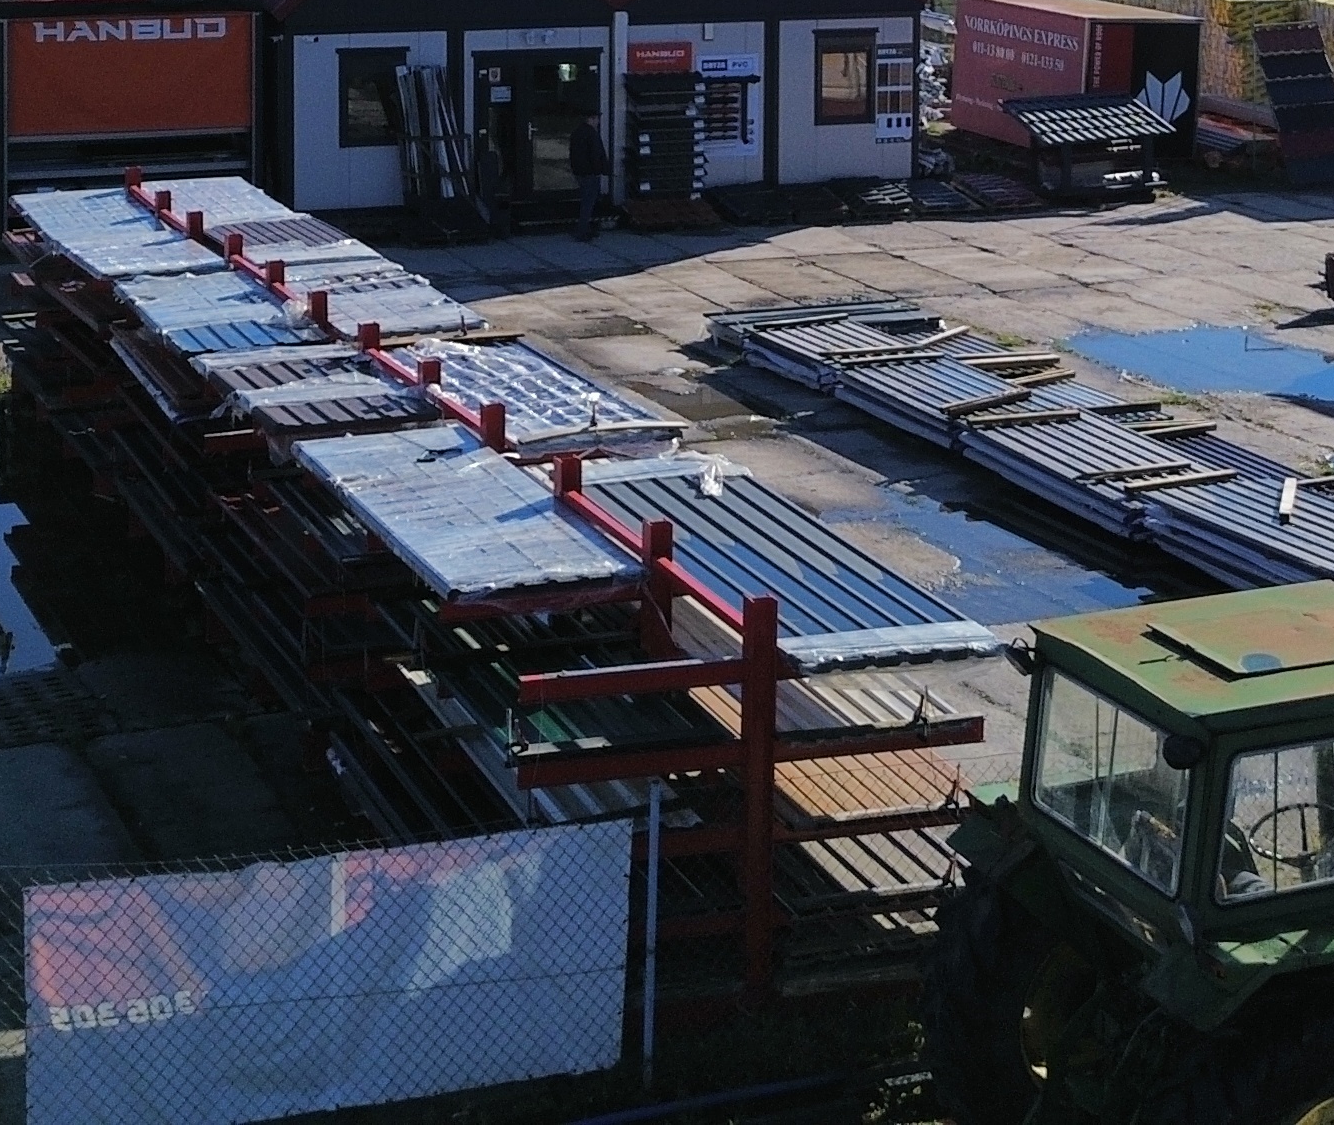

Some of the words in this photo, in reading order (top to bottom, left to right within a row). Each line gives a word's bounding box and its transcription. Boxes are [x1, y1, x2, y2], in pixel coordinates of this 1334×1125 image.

[33, 18, 226, 43] HANBUD
[964, 15, 1032, 43] NORRKÖPINGS
[1034, 29, 1079, 52] EXPRESS
[732, 60, 749, 68] PVC
